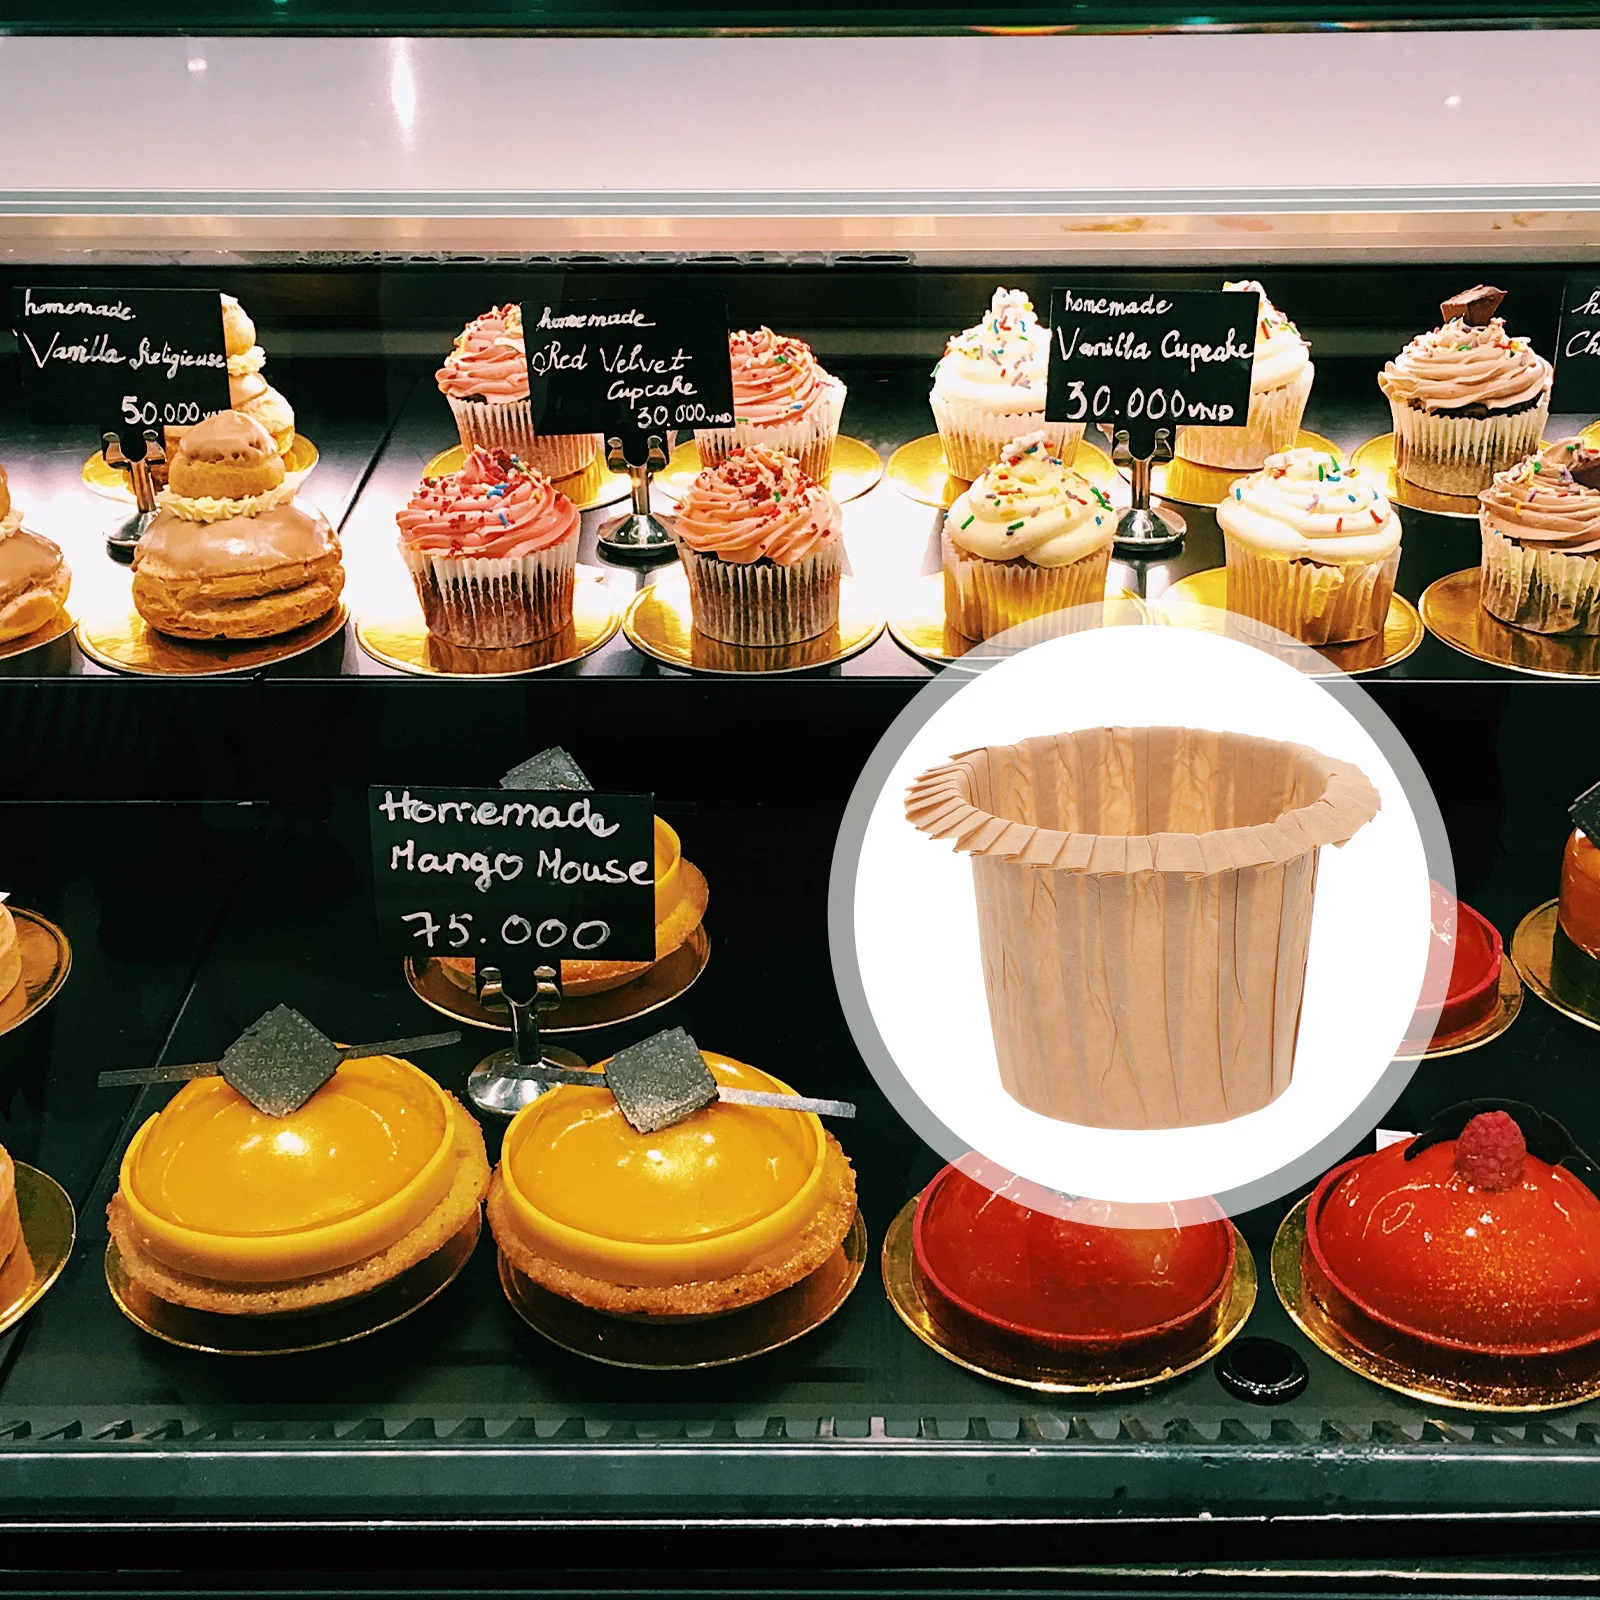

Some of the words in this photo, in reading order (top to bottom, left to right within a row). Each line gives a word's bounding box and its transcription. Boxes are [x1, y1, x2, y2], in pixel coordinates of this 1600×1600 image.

[1064, 289, 1173, 317] homemade
[22, 330, 127, 369] Vanilla
[532, 340, 588, 376] Red
[599, 344, 693, 373] Velvet
[1056, 325, 1152, 361] Vanilla
[1160, 327, 1254, 373] Cupcake
[606, 375, 698, 410] Cupcake
[379, 790, 621, 838] Homemade
[390, 839, 524, 893] Mango
[536, 847, 655, 886] Mouse
[401, 911, 611, 950] 75.000
